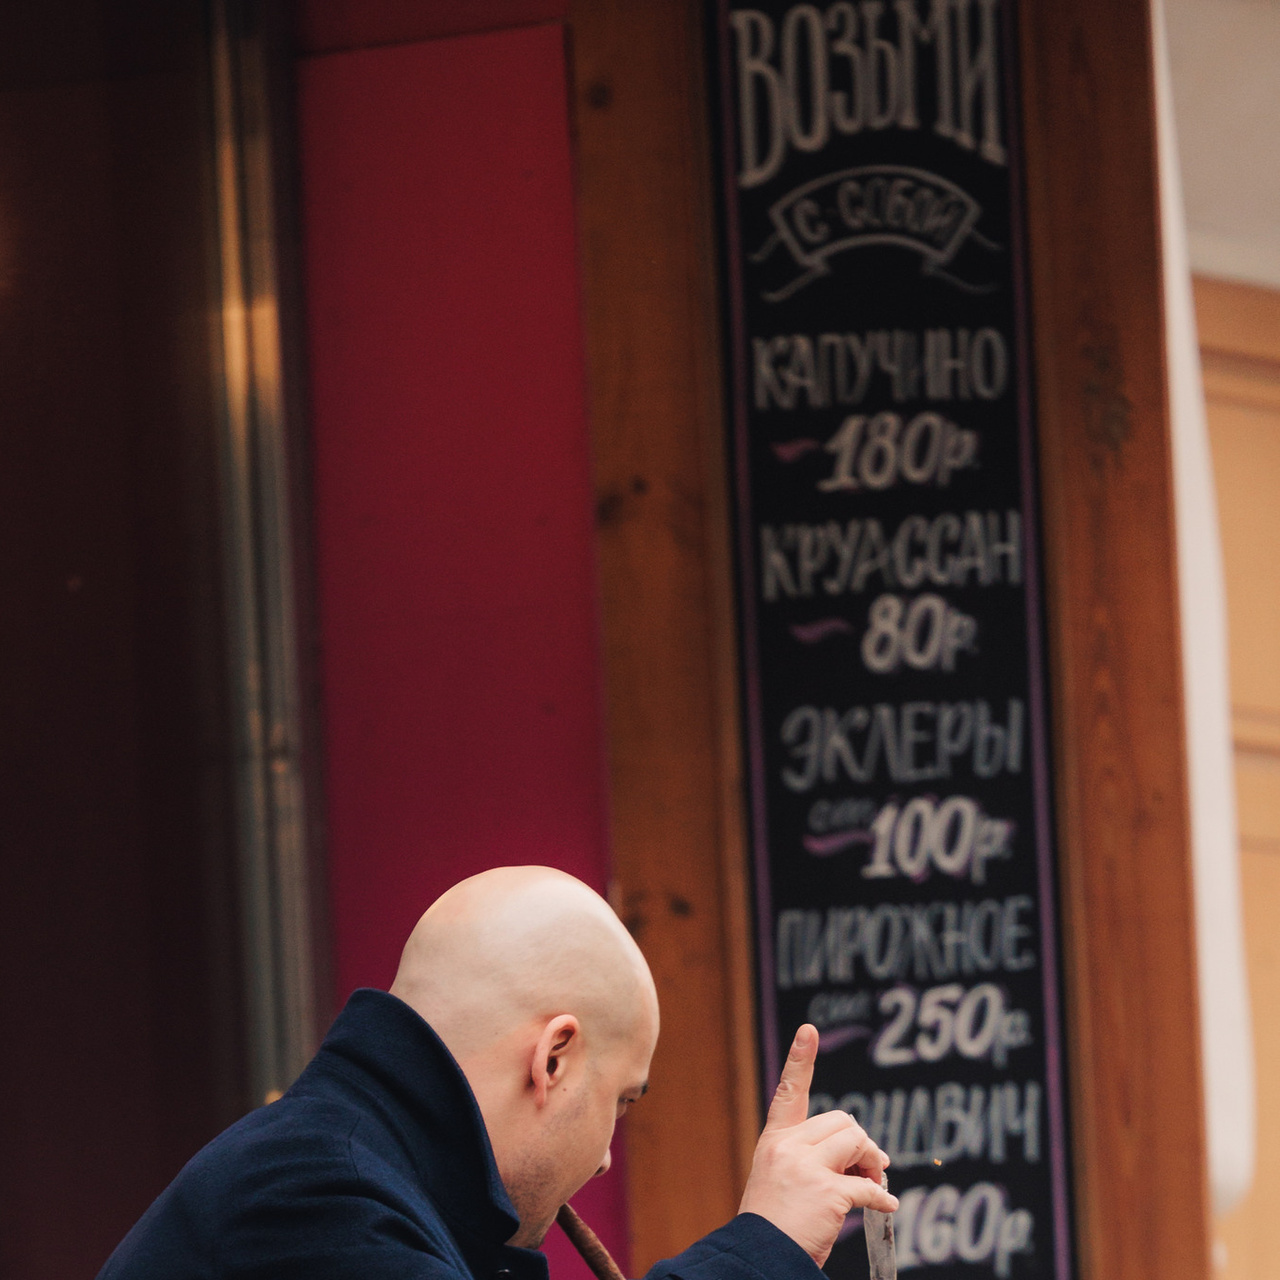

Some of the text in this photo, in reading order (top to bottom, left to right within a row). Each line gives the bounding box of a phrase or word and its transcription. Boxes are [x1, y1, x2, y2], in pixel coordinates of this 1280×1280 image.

[760, 510, 1023, 602] КРУАССАН
[780, 700, 1024, 792] ЭКЛЕРЫ
[777, 894, 1036, 989] ПИРОЖНОЕ
